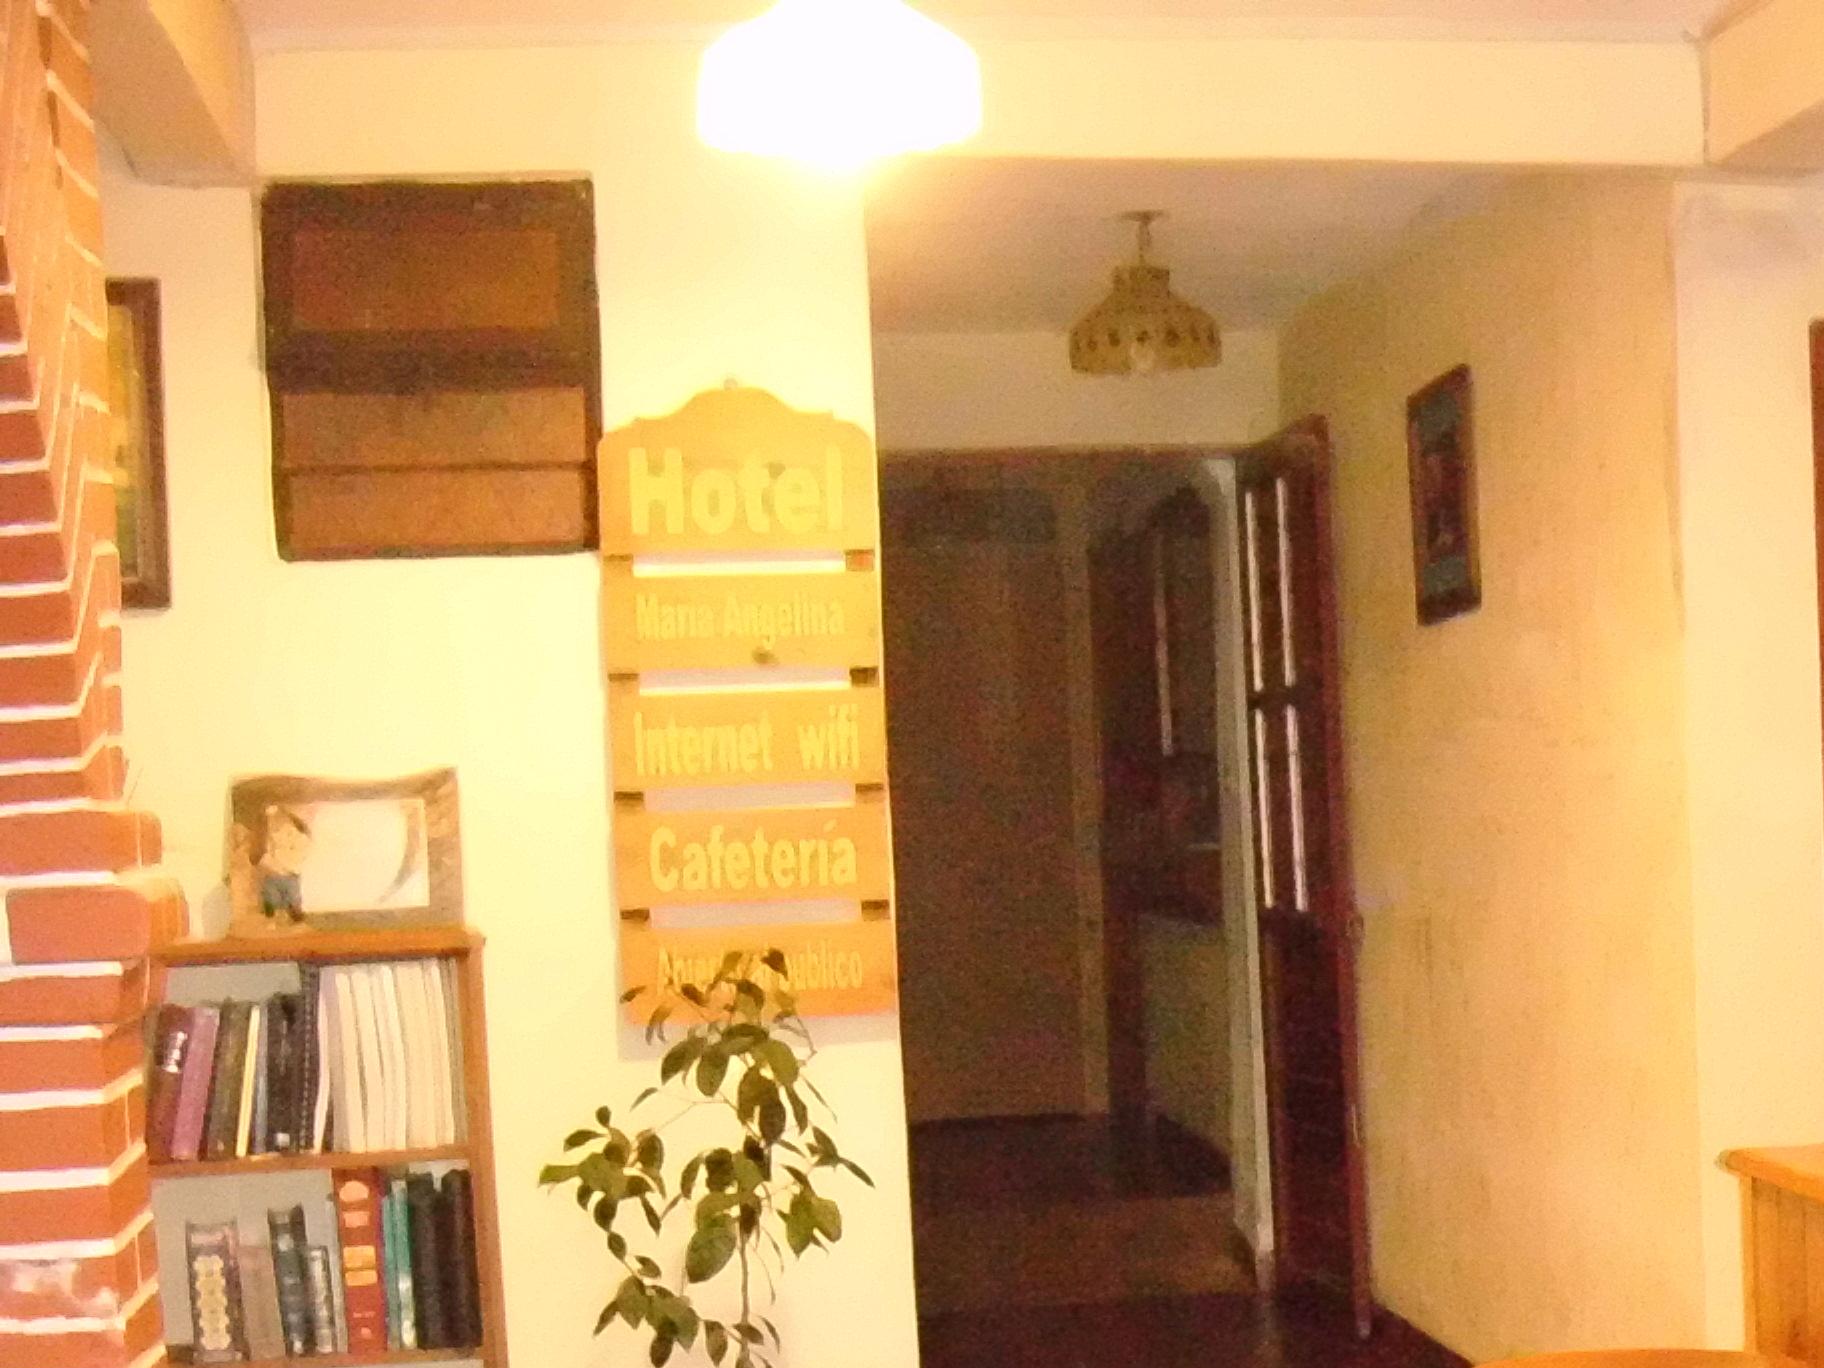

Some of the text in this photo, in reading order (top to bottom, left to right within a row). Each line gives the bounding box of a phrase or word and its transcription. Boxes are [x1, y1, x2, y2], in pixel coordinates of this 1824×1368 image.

[628, 443, 844, 535] Hotel
[724, 590, 845, 649] Angelina
[634, 703, 860, 776] Internet wifi
[651, 819, 857, 892] Cafetería
